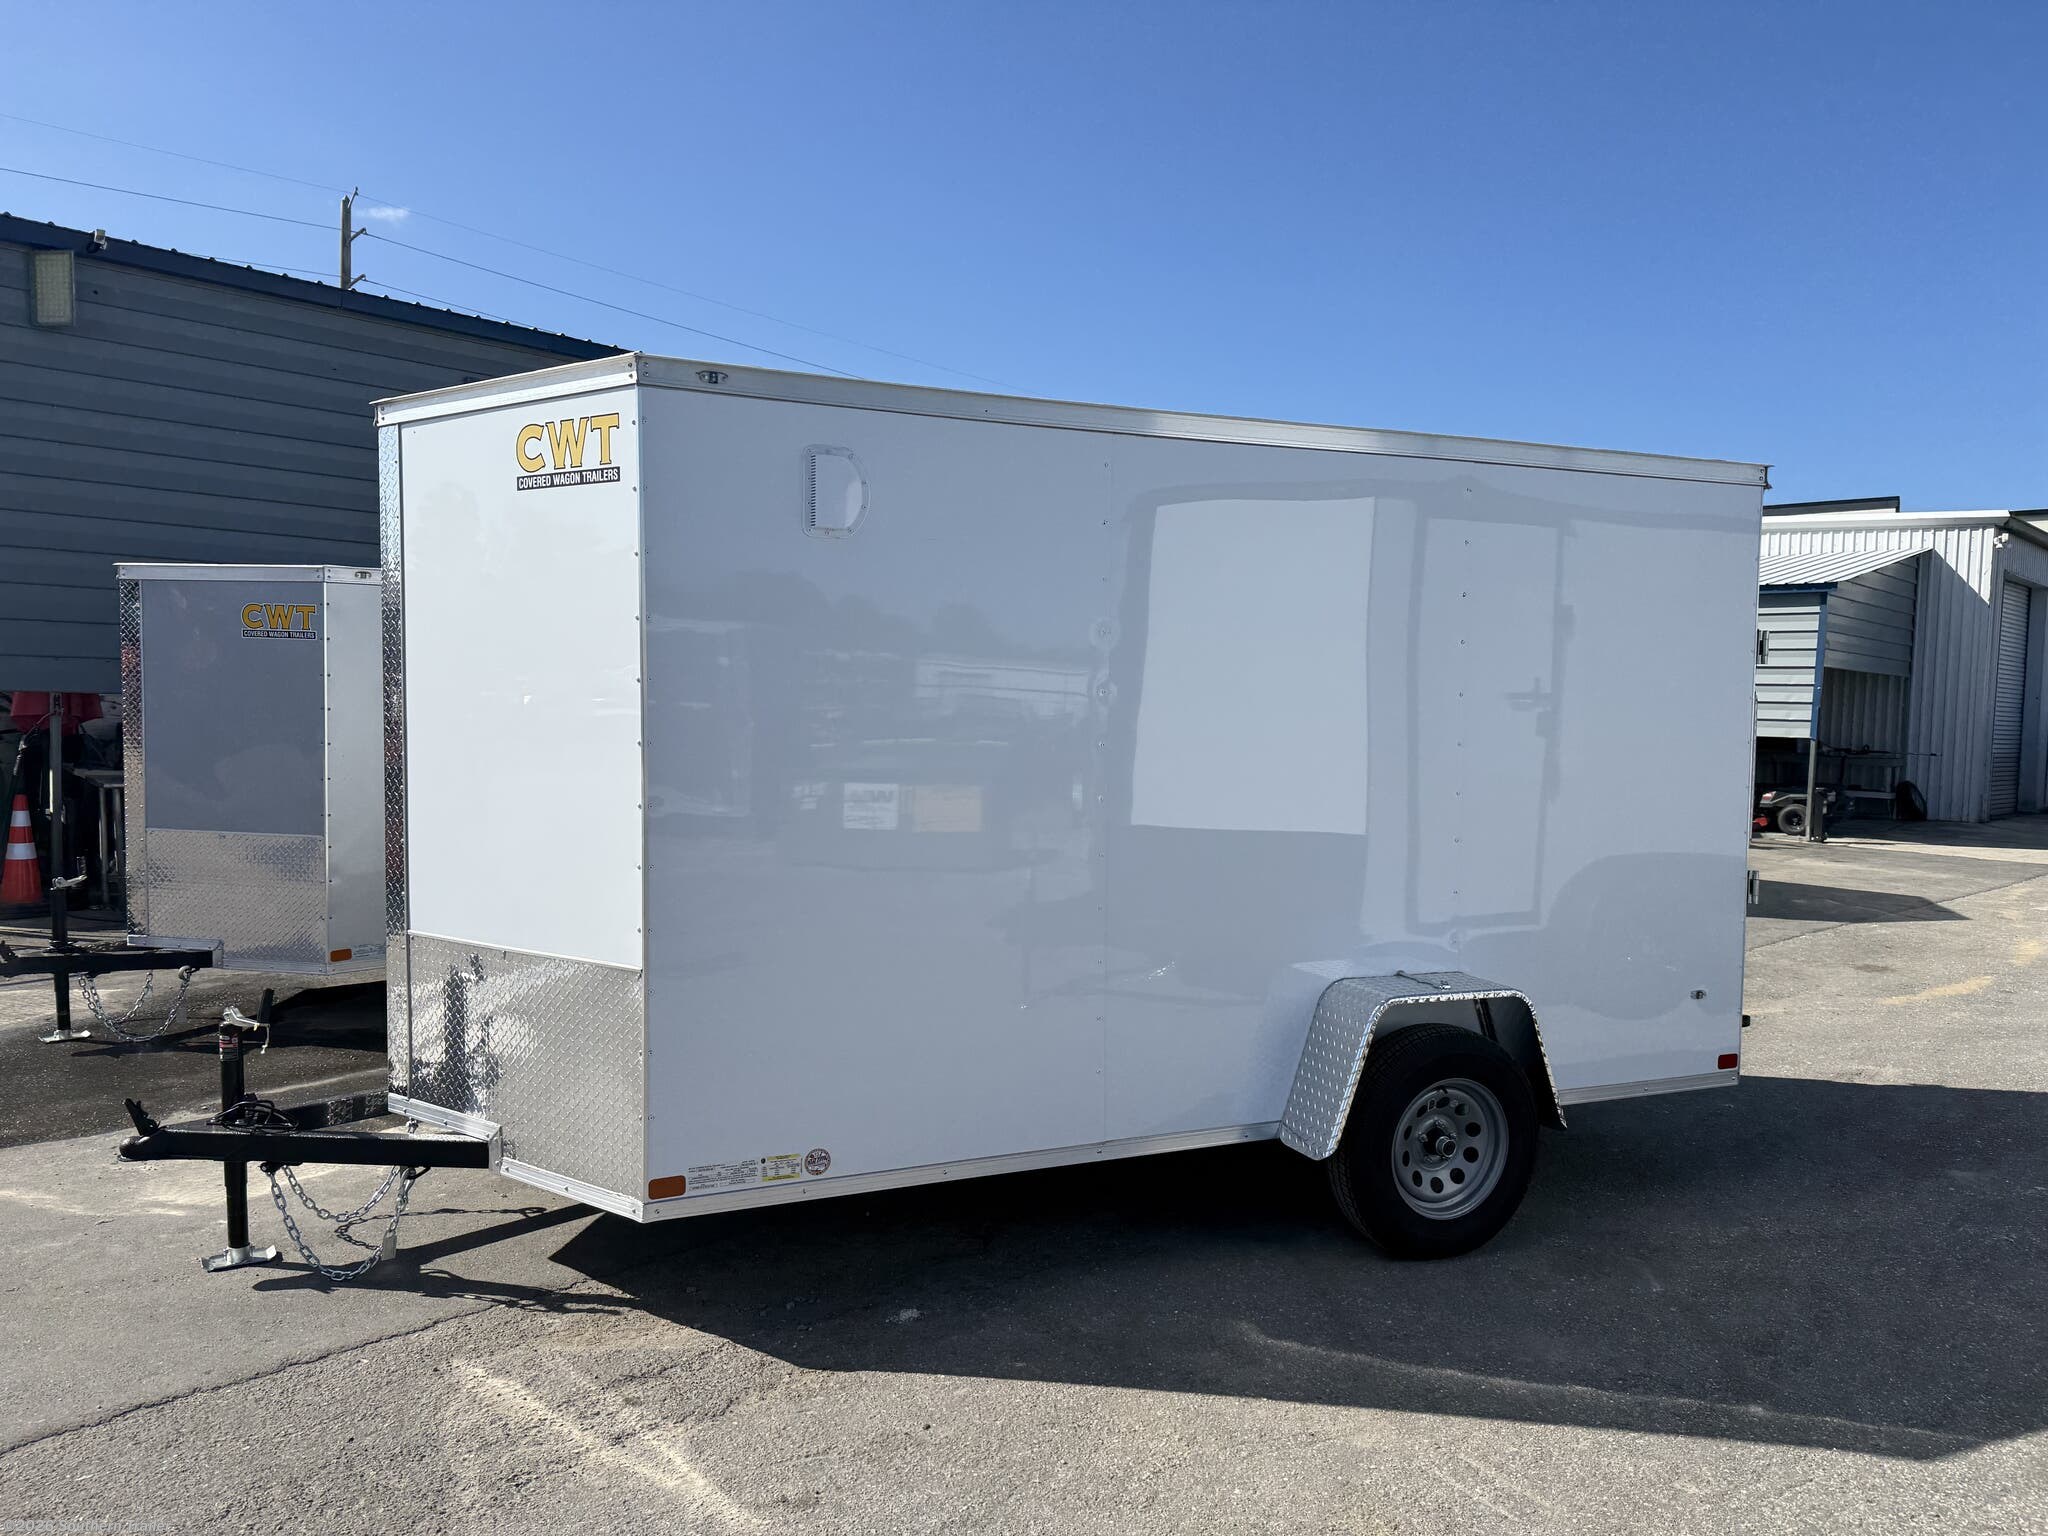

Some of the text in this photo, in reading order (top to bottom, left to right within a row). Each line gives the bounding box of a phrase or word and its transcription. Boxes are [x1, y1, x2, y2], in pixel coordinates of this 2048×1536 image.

[516, 412, 620, 473] CWT
[518, 468, 619, 489] COVERED WAGON TRAILERS
[242, 603, 316, 630] CWT
[290, 631, 315, 639] TRAILERS
